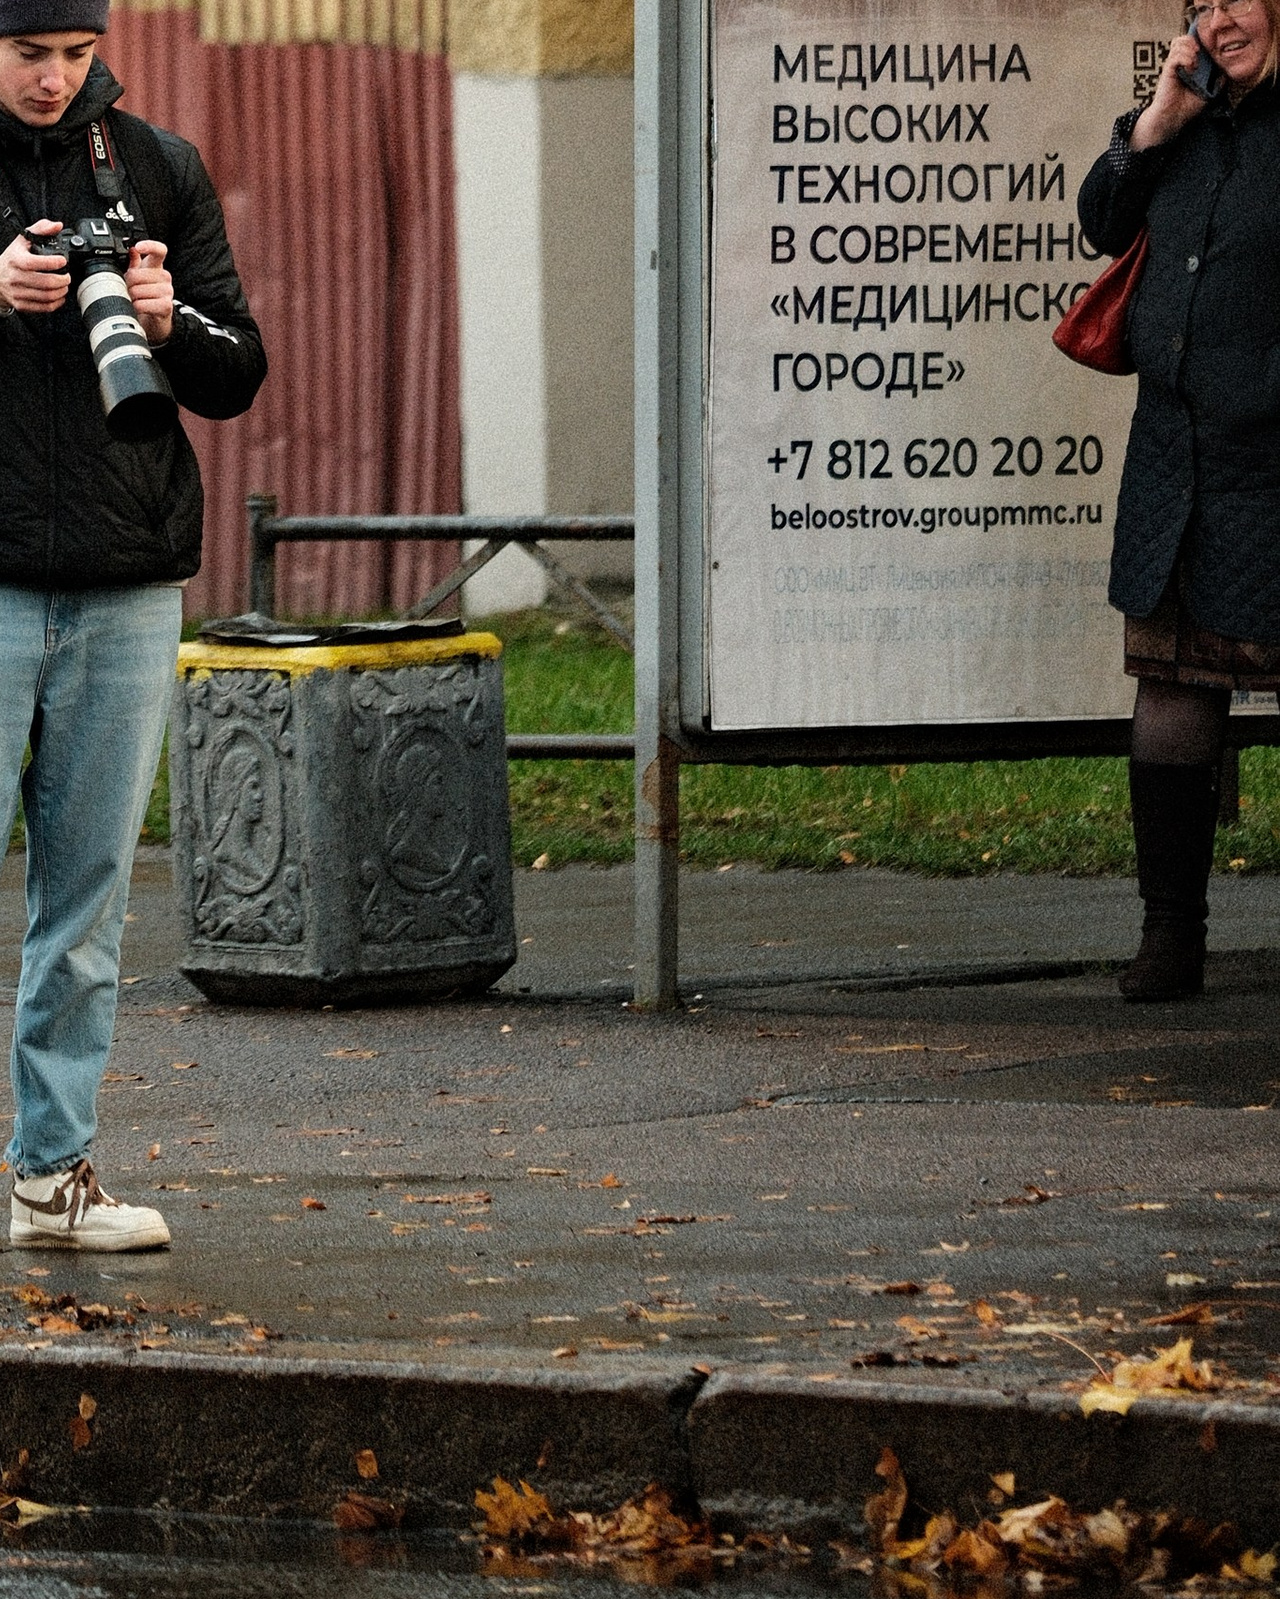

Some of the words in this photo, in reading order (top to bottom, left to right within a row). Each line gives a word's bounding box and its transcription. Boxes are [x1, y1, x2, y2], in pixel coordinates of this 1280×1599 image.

[773, 43, 1032, 91] МЕДИЦИНА
[772, 103, 990, 144] ВЫСОКИХ
[93, 134, 107, 160] EOS
[769, 152, 1066, 204] ТЕХНОЛОГИЙ
[771, 225, 796, 264] В
[773, 351, 966, 399] ГОРОДЕ»
[767, 439, 814, 480] +7
[827, 438, 893, 480] 812
[903, 436, 978, 479] 620
[991, 435, 1044, 478] 20
[1055, 434, 1104, 477] 20
[771, 503, 1103, 535] beloostrov.groupmmc.ru
